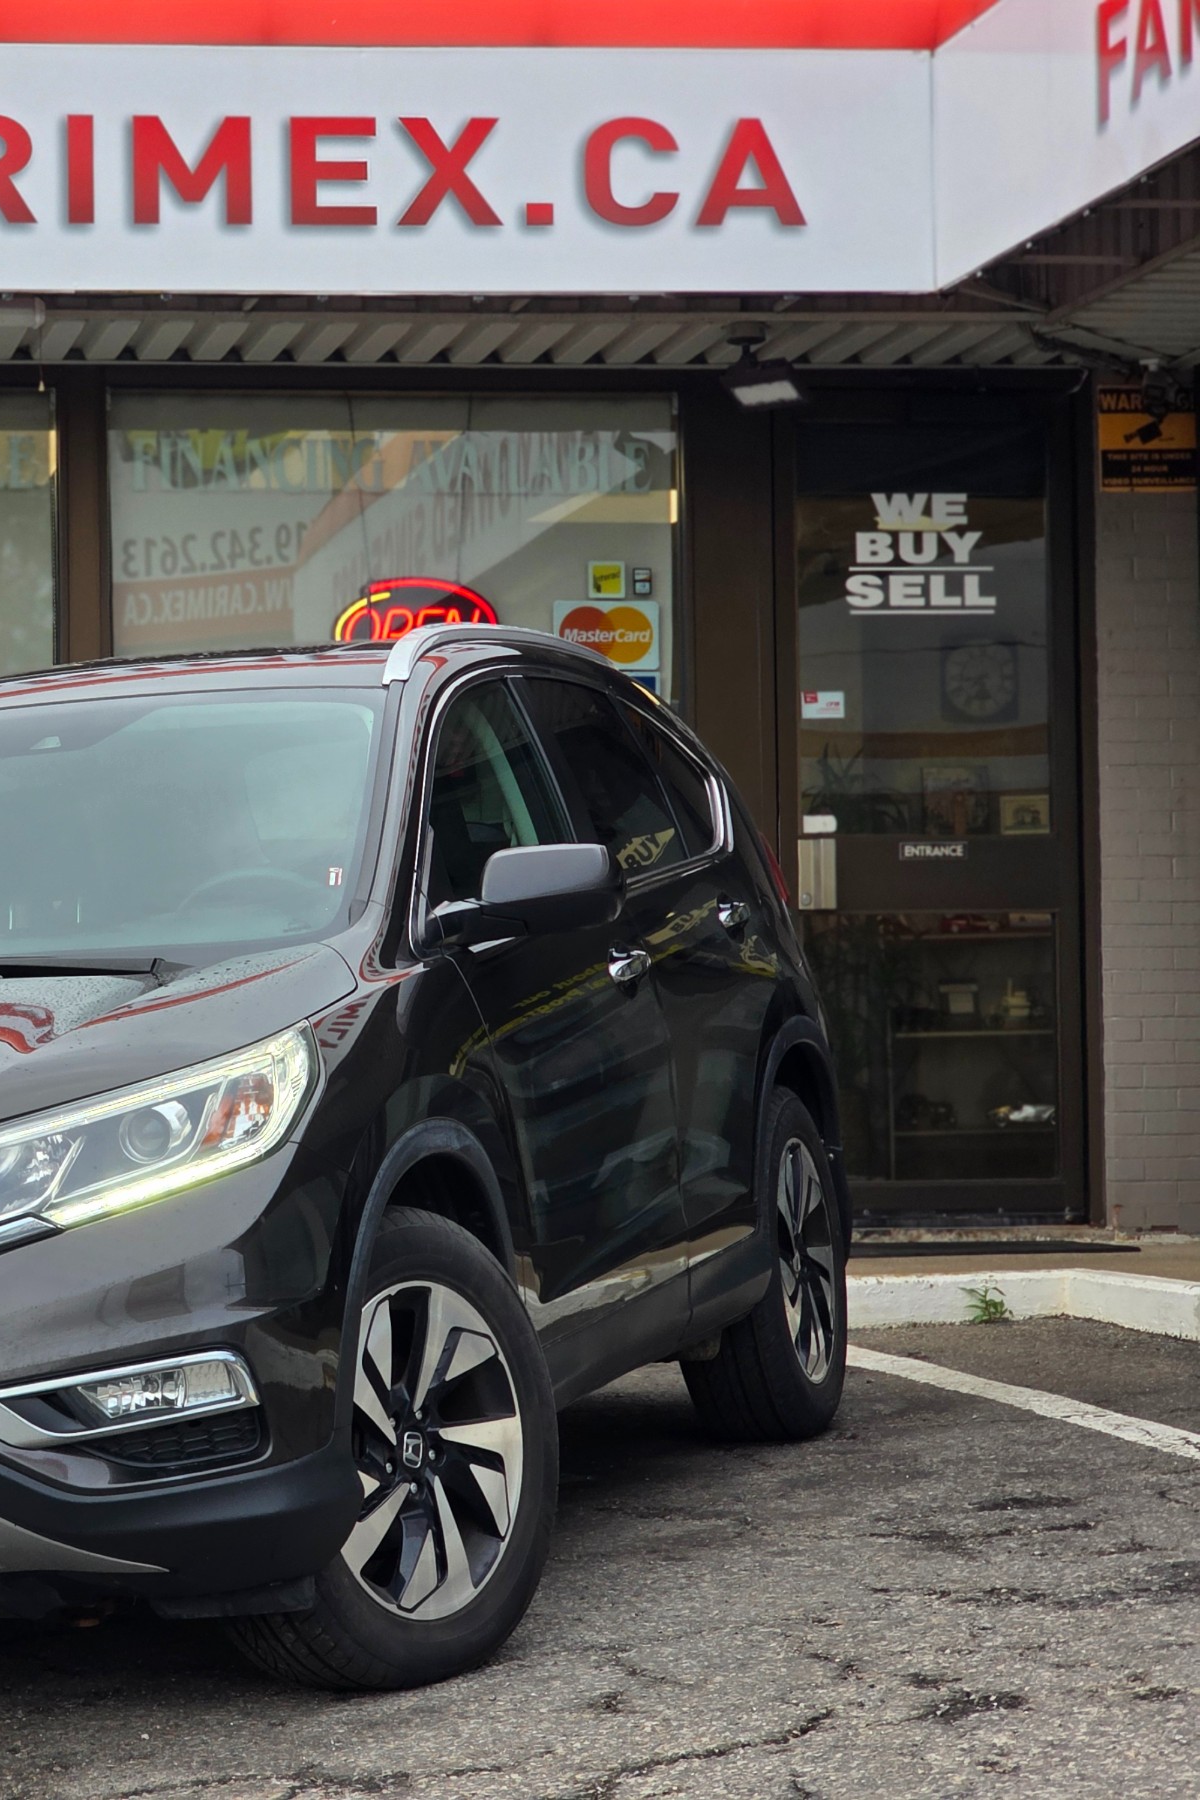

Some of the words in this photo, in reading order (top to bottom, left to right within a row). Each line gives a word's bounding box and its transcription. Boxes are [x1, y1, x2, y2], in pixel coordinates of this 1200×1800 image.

[132, 436, 383, 493] FINANCING
[408, 437, 652, 493] AVAILABLE
[871, 493, 968, 525] WE
[855, 531, 983, 564] BUY
[845, 574, 997, 607] SELL
[563, 625, 651, 645] MasterCard
[904, 844, 964, 858] ENTRANCE
